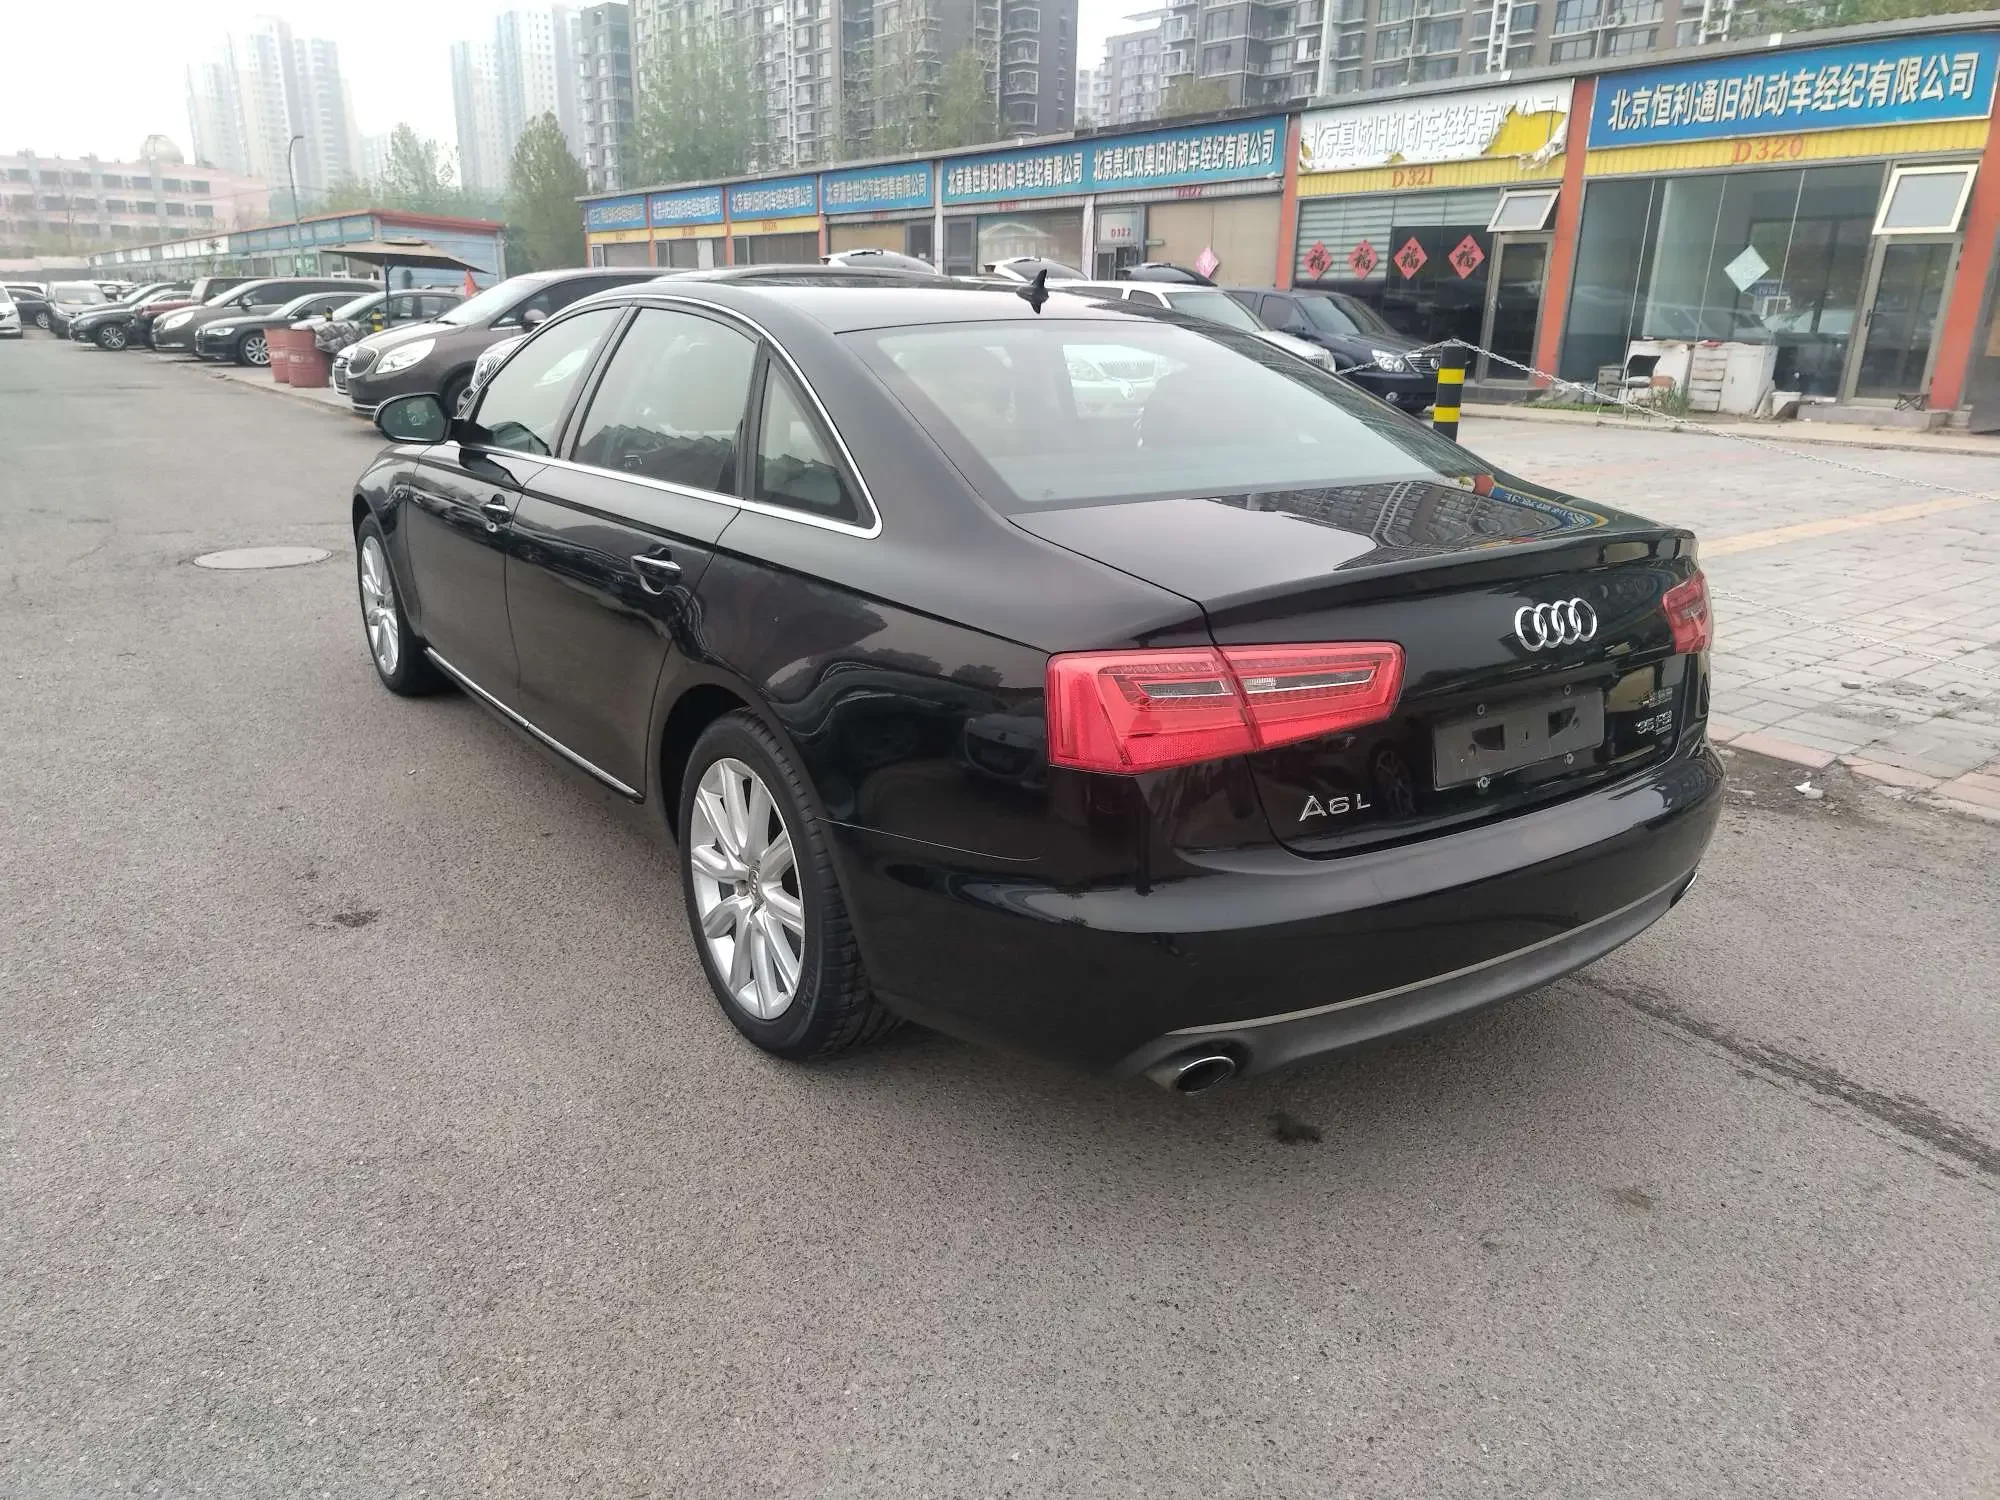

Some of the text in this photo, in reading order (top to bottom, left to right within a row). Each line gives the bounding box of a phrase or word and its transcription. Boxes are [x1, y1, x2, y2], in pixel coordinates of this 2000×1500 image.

[1607, 51, 1981, 132] 北京恒利通旧机动车经纪有限公司
[1732, 137, 1804, 163] D320
[1391, 167, 1434, 188] D321
[1299, 793, 1371, 821] A6L
